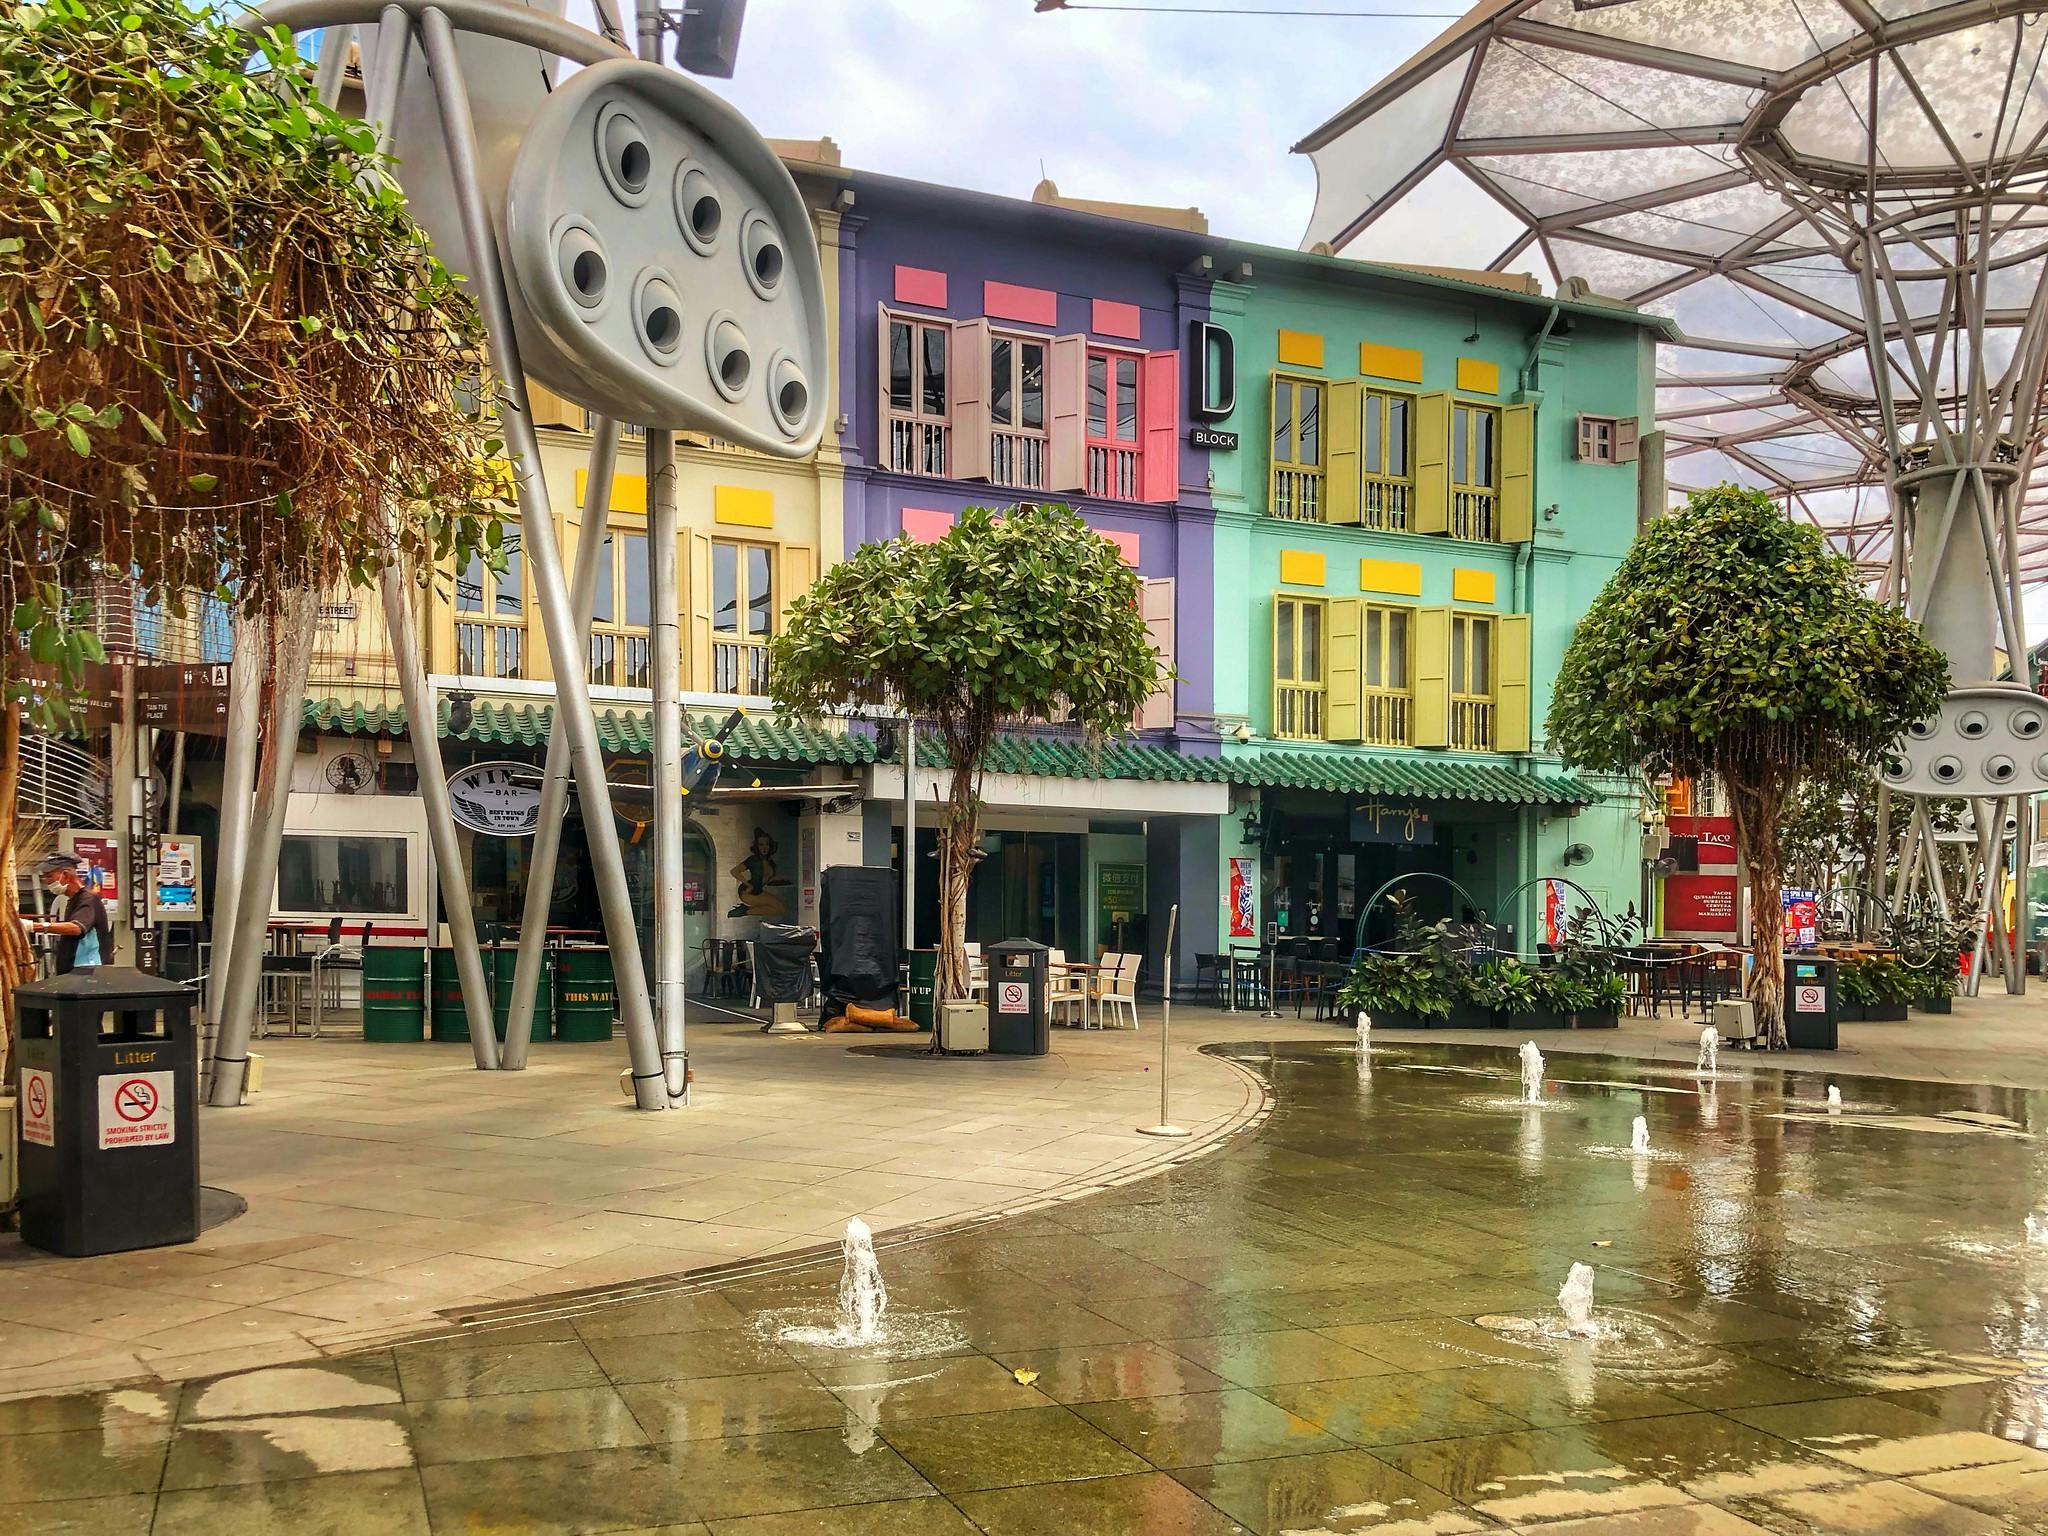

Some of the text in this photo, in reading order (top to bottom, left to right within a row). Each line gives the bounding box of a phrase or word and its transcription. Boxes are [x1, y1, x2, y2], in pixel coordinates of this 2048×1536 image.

[1192, 320, 1236, 420] D
[1196, 432, 1235, 447] BLOCK
[326, 606, 353, 615] STREET
[215, 668, 224, 680] A
[146, 711, 164, 719] PLACE
[145, 790, 158, 849] QUAY
[132, 833, 146, 918] CLARKE
[565, 992, 610, 1002] THIS WAY
[919, 987, 932, 995] UP
[115, 1050, 157, 1065] Litter
[106, 1122, 168, 1135] SMOKING STRICTLY
[104, 1134, 144, 1145] PROHIBITED
[155, 1132, 170, 1140] LAW
